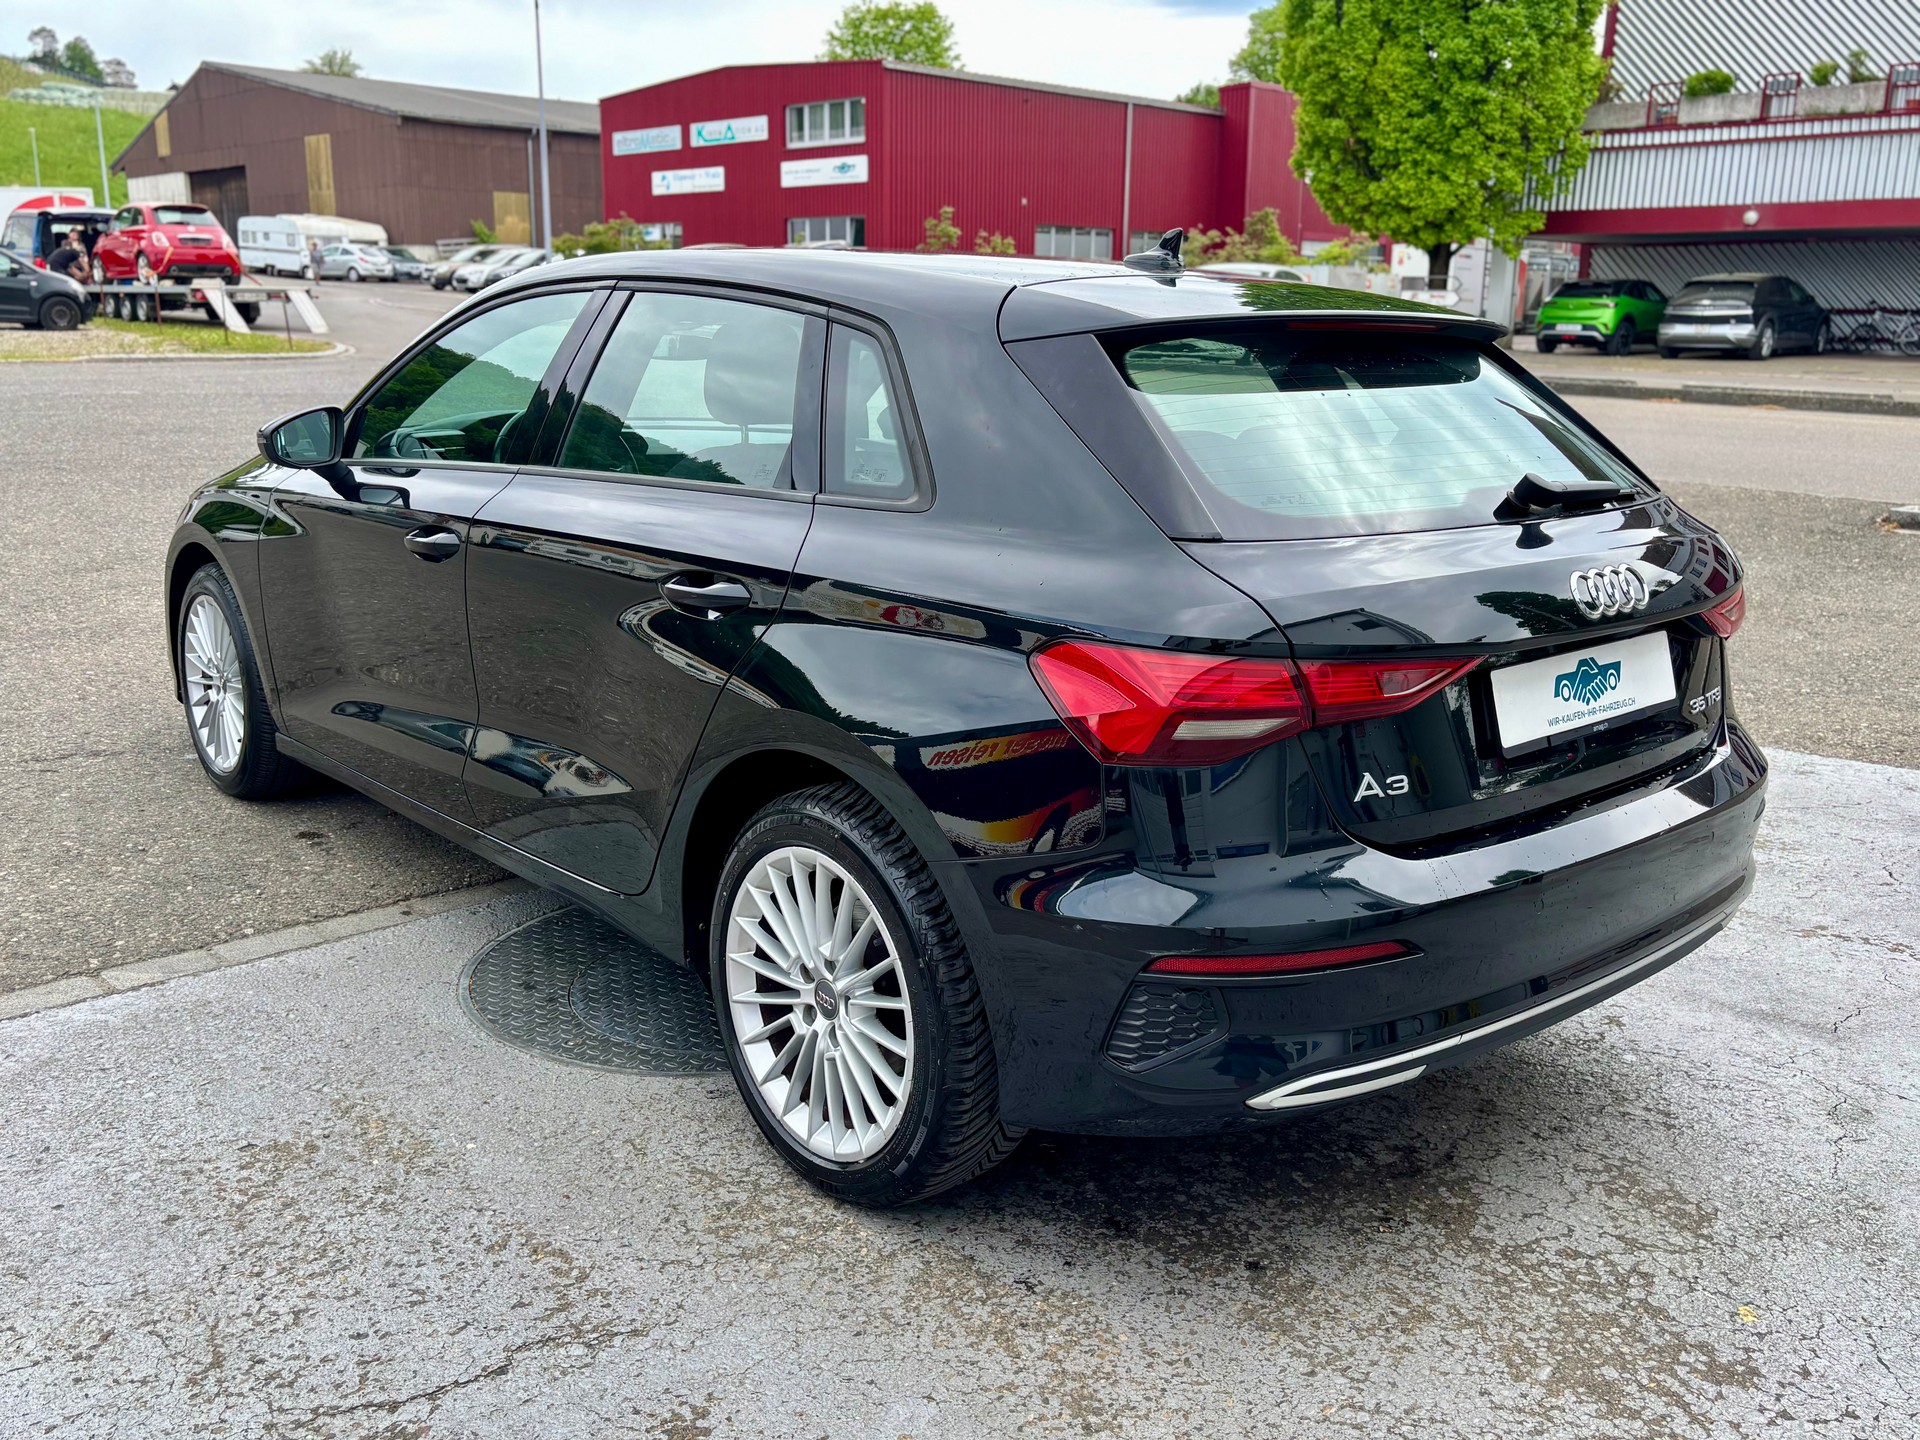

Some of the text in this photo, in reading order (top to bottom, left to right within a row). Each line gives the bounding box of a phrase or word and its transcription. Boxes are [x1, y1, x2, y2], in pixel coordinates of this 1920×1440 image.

[1547, 697, 1636, 727] WIR-KAUFEN-IHR-FAHRZEUG.CH
[1690, 697, 1706, 714] 35
[1353, 772, 1409, 802] A3
